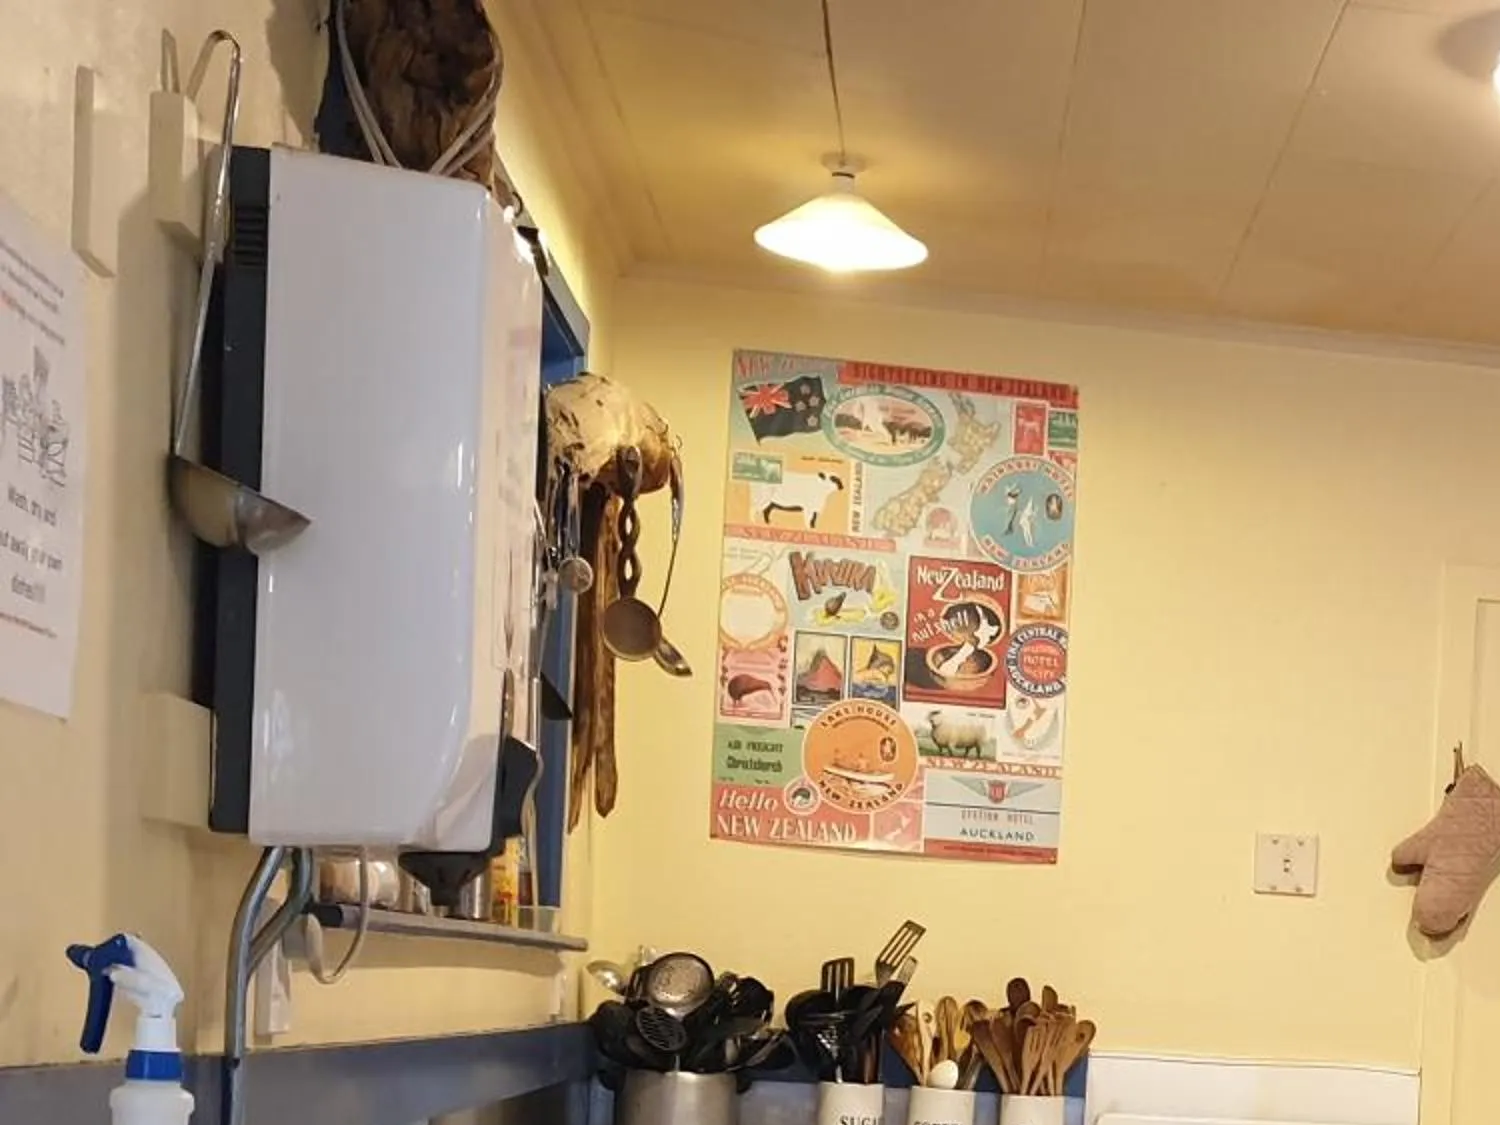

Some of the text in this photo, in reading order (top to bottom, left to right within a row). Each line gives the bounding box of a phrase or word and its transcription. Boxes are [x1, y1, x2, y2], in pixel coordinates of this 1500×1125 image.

[719, 789, 779, 812] Hello
[717, 814, 858, 842] NEW ZEALAND
[959, 827, 1036, 842] AUCKLAND
